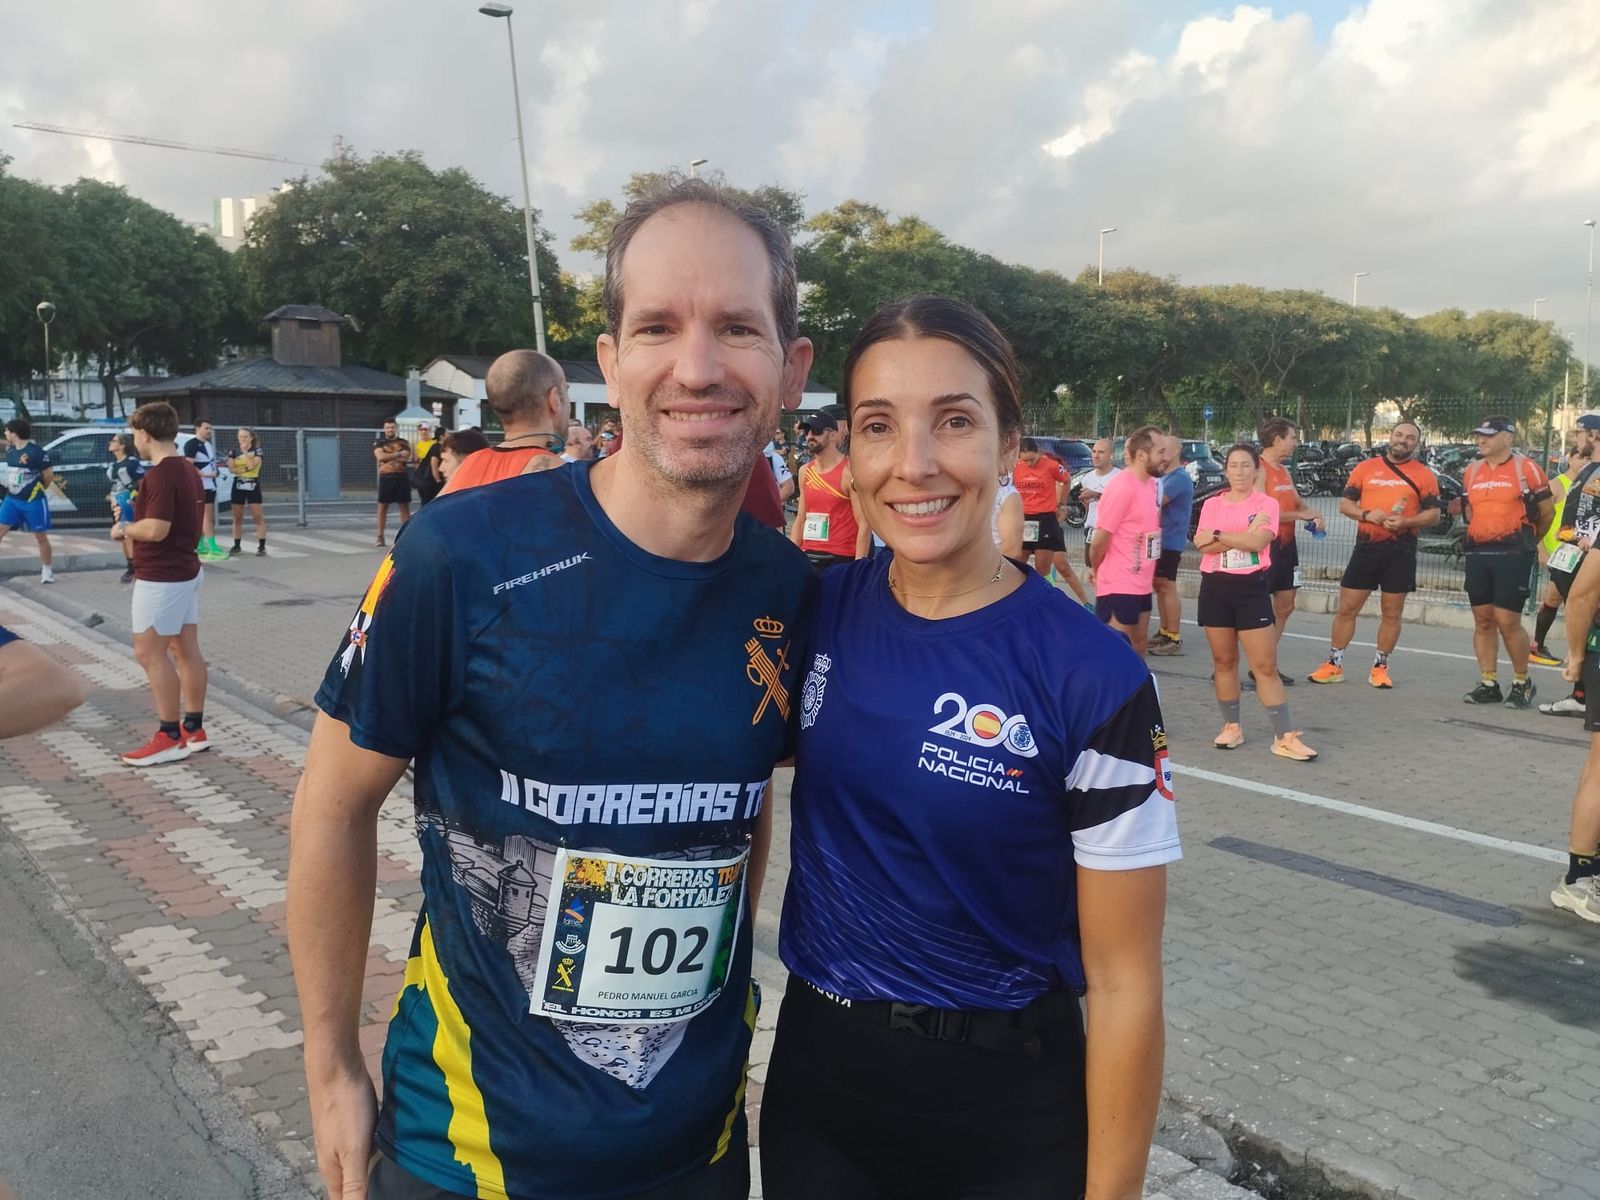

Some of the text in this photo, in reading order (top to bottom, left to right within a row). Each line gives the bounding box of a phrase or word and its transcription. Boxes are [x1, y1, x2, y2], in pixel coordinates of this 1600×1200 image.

[493, 552, 594, 595] FIREHAWK
[918, 757, 1030, 794] NACIONAL
[523, 777, 741, 825] CORRERÍAS
[619, 864, 715, 888] CORRERAS
[610, 883, 736, 908] LA FORTALEZ
[604, 926, 709, 976] 102
[598, 988, 698, 1001] PEDRO MANUEL GARCIA
[571, 1007, 642, 1018] HONOR
[649, 1009, 673, 1018] ES
[674, 1005, 692, 1016] MI
